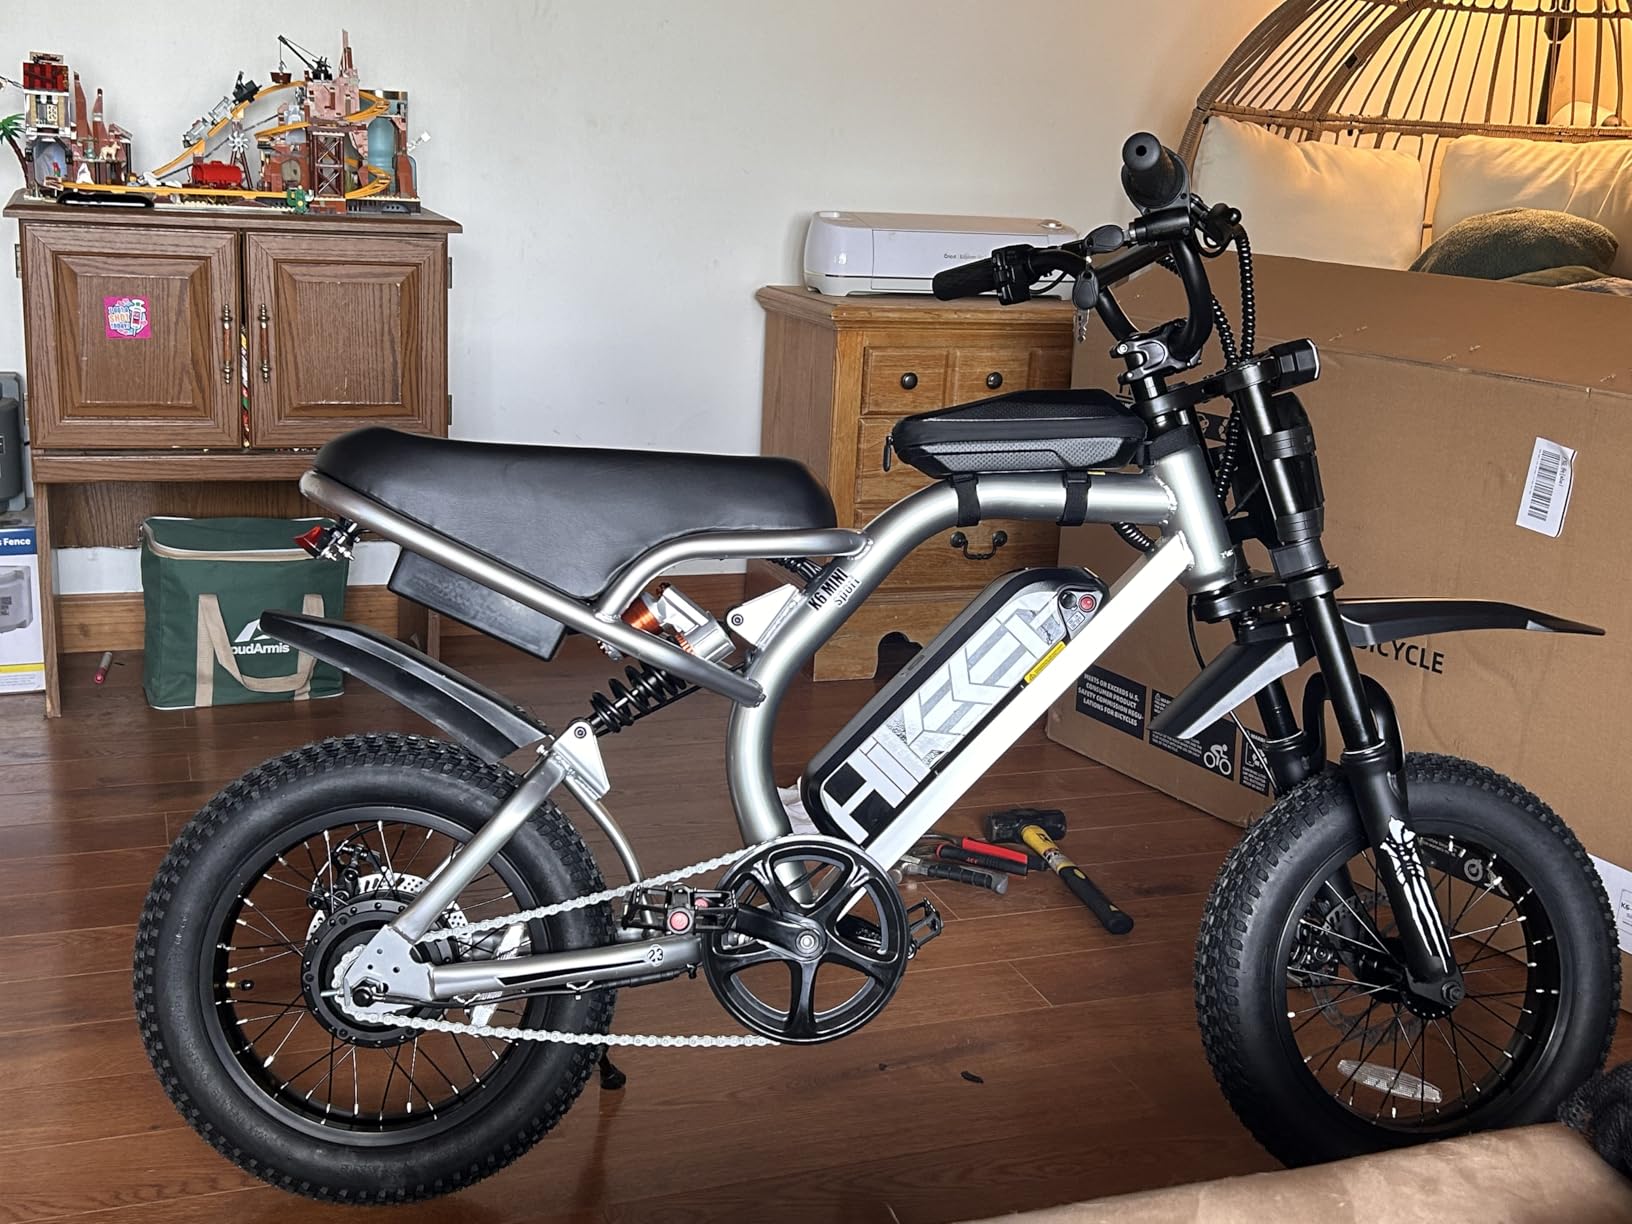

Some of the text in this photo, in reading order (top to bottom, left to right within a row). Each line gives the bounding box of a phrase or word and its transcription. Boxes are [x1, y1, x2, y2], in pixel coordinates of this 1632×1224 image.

[3, 537, 31, 545] Fence
[808, 567, 848, 611] K6 MINI
[231, 642, 290, 655] oudArmis
[1355, 640, 1445, 675] CYCLE
[1099, 680, 1108, 688] OR
[1078, 686, 1097, 700] SAFETY
[1086, 682, 1113, 699] CONSUMER
[1112, 693, 1137, 709] PRODUCT
[1083, 697, 1104, 711] LATIONS
